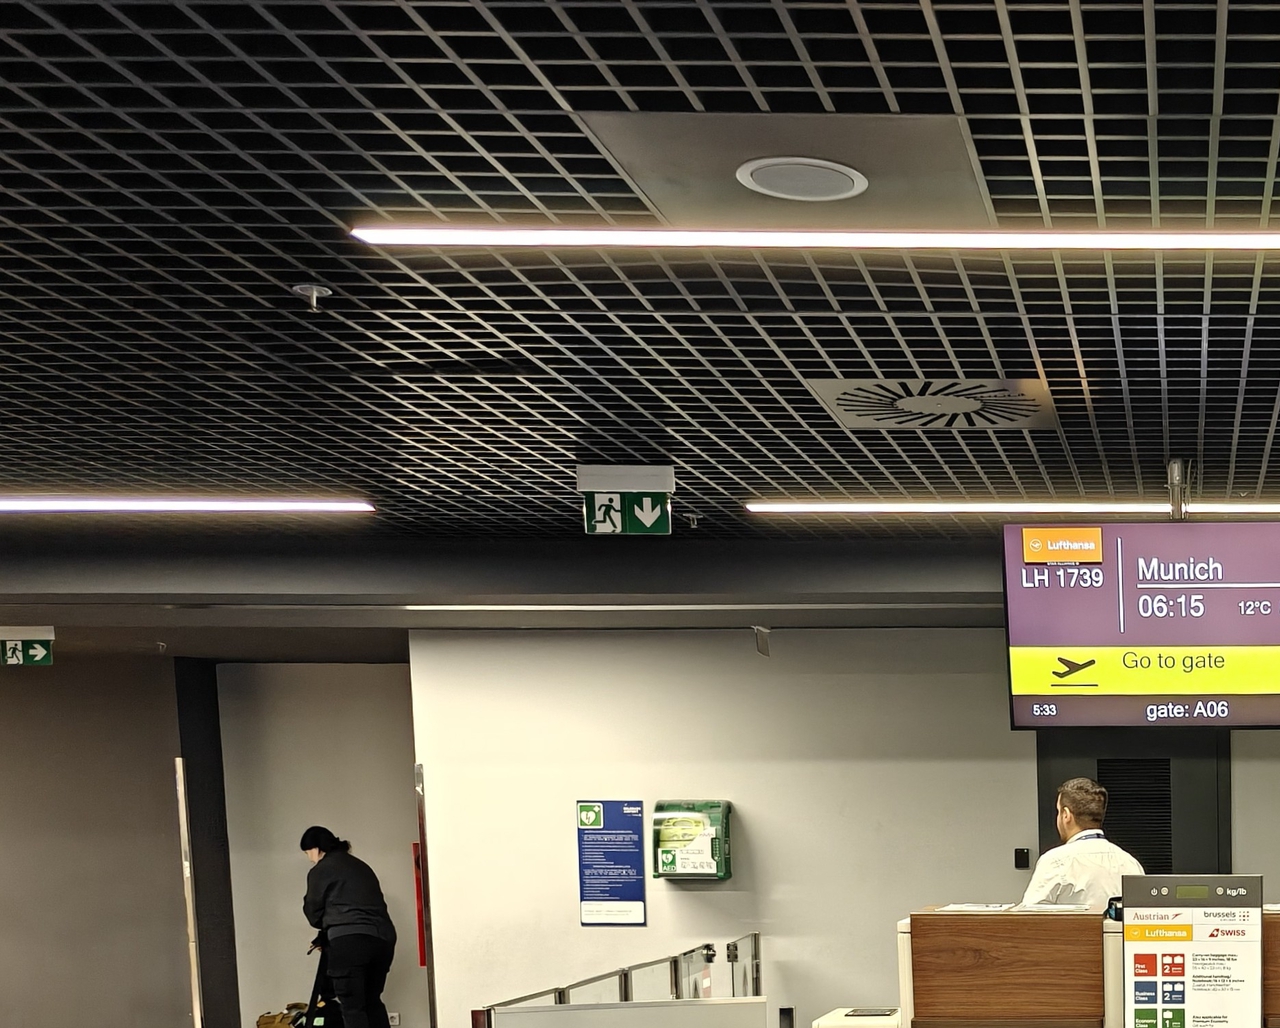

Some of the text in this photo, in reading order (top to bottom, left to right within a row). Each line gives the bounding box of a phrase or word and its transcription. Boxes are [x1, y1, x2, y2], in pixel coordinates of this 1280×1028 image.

[1047, 540, 1096, 550] Lufthansa
[1137, 557, 1224, 581] Munich
[1021, 568, 1104, 588] LH 1739
[1137, 594, 1205, 618] 06:15
[1238, 600, 1272, 616] 12°C
[1122, 651, 1226, 673] Go to gate
[1032, 704, 1057, 716] 5:33
[1146, 702, 1229, 722] gate: A06
[1226, 888, 1247, 897] kg/lb
[1133, 912, 1170, 921] Austrian
[1145, 929, 1187, 938] Lufthansa
[1220, 929, 1246, 937] SWISS
[1163, 965, 1171, 974] 2
[1163, 992, 1171, 1001] 2
[1165, 1020, 1170, 1028] 1
